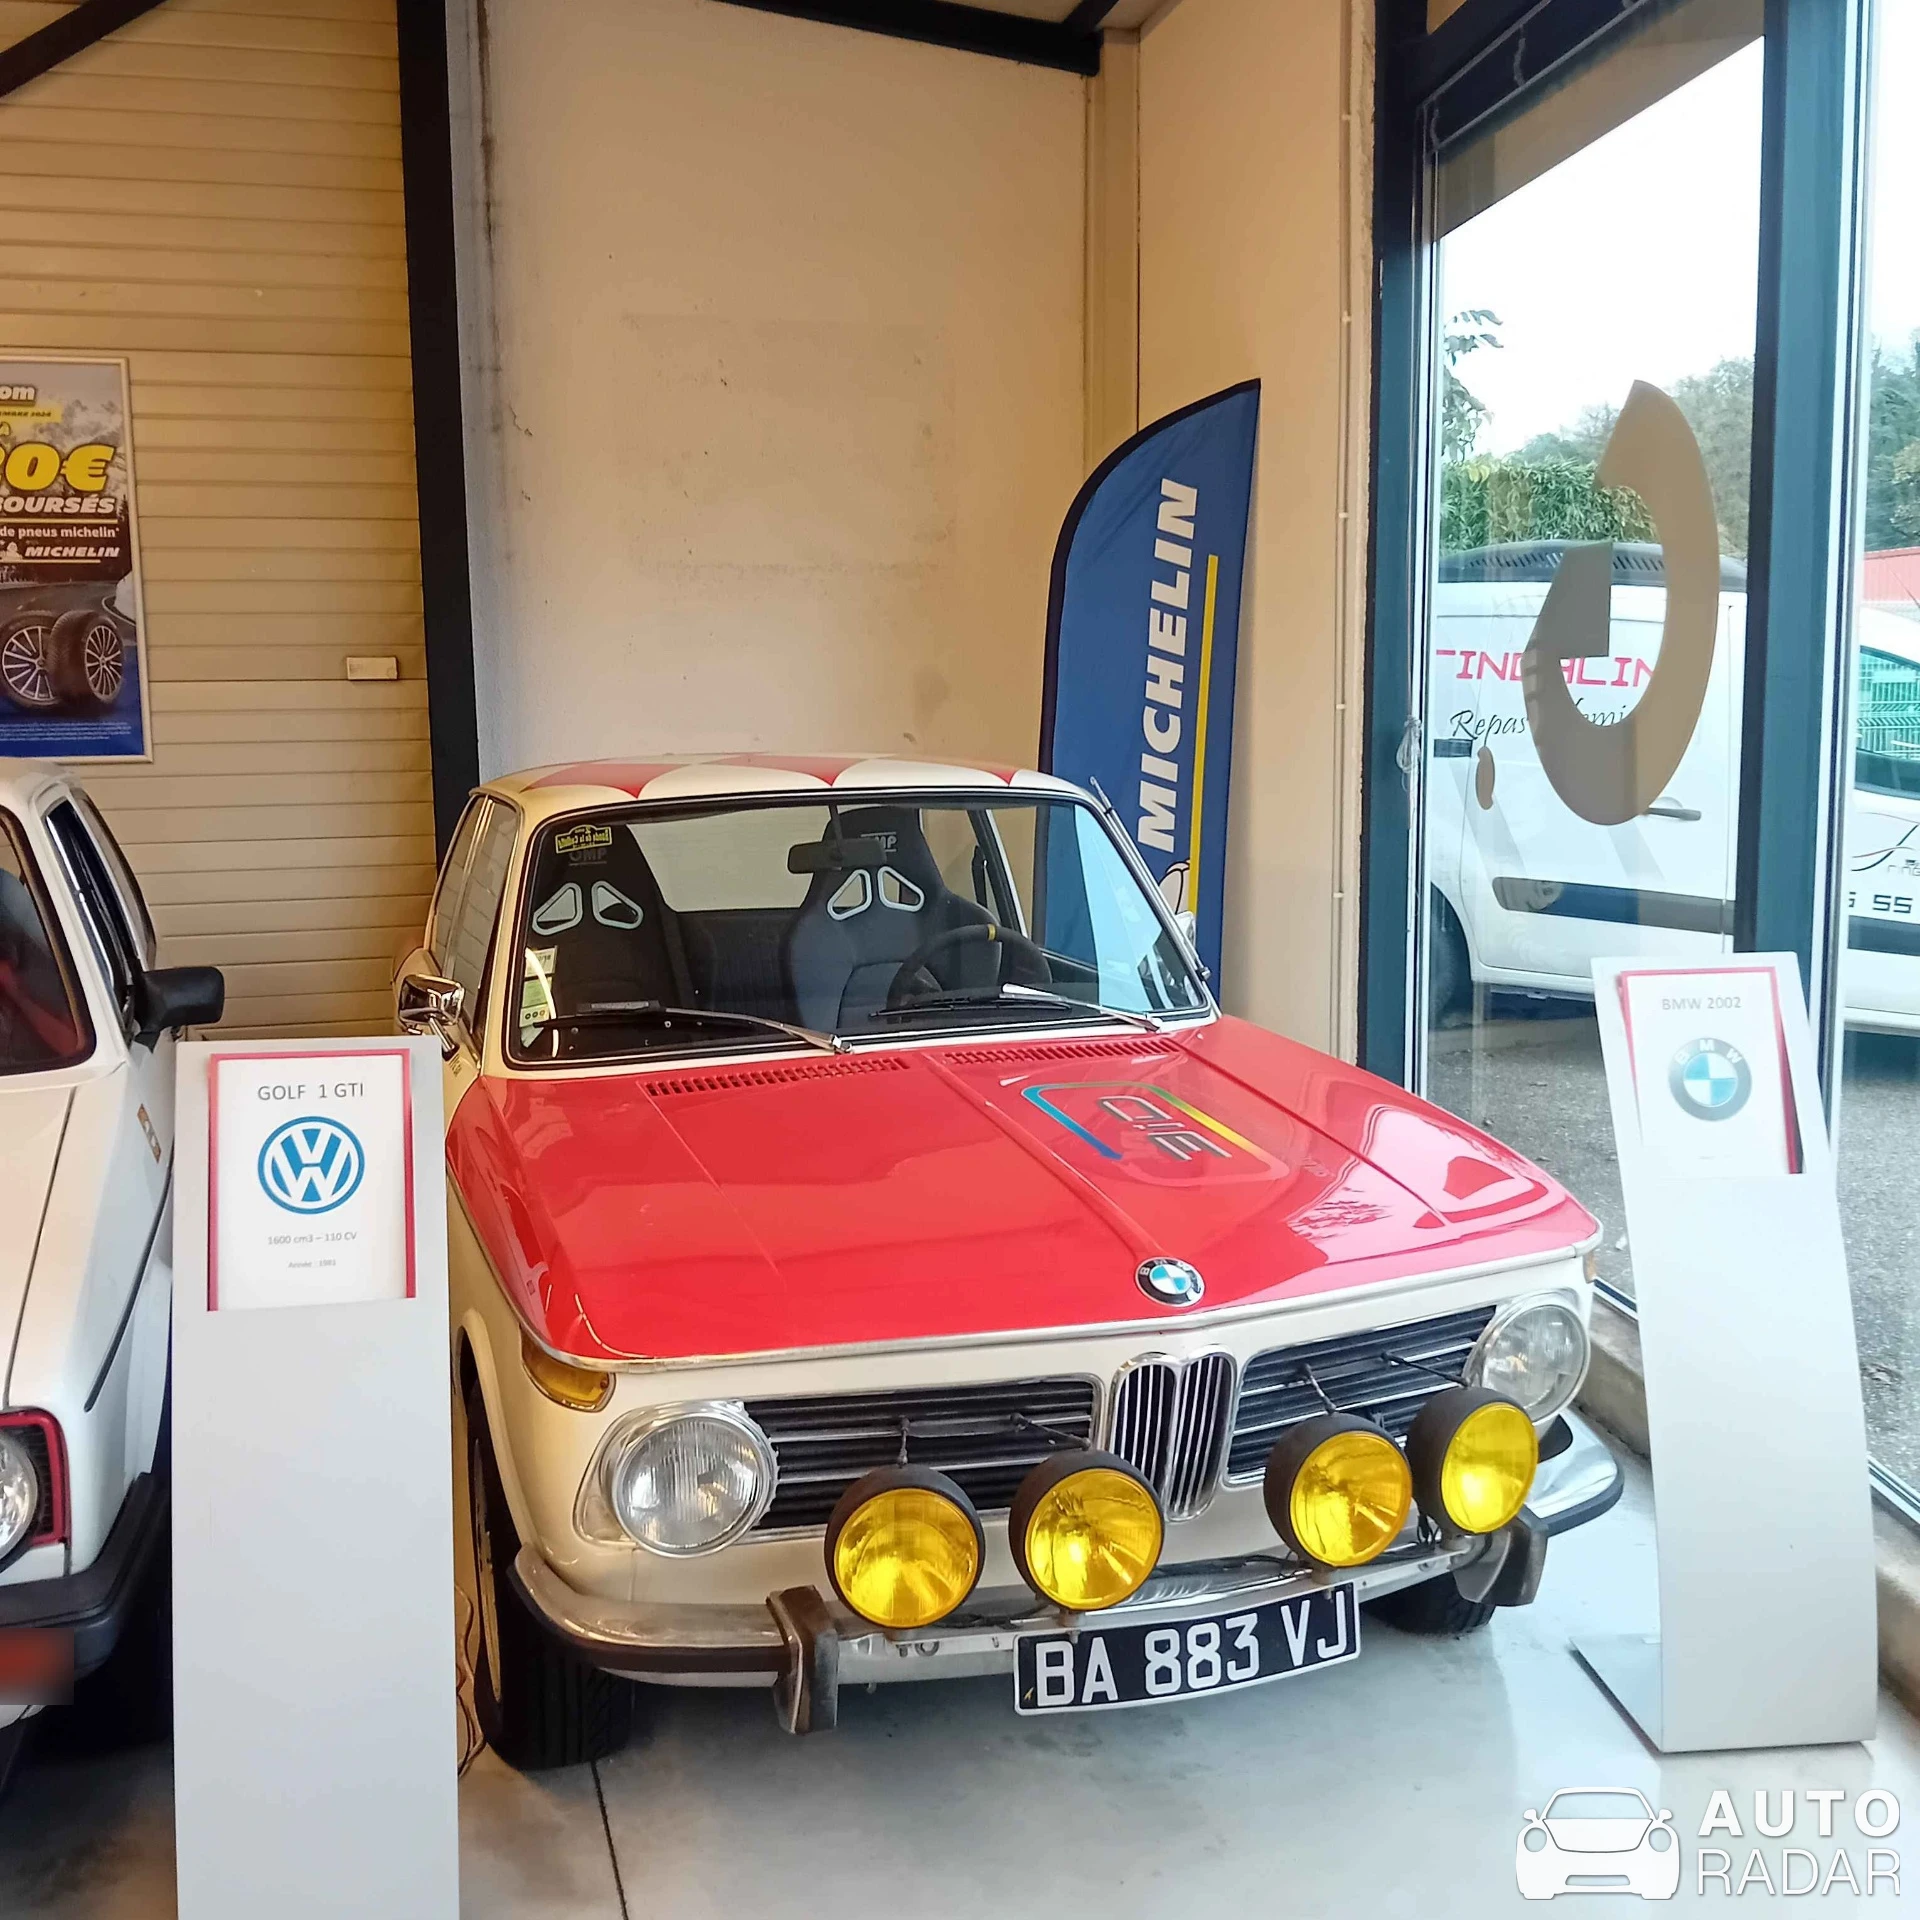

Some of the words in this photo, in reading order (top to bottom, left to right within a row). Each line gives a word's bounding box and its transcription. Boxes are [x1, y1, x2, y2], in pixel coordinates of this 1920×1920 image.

[0, 441, 116, 492] 0€
[0, 493, 116, 515] OURSÉS
[18, 527, 58, 540] pneus
[25, 546, 120, 558] MICHELIN
[1138, 478, 1198, 853] MICHELIN
[1662, 998, 1702, 1010] BMW
[1707, 996, 1741, 1009] 2002
[257, 1084, 306, 1101] GOLF
[318, 1084, 328, 1099] 1
[334, 1082, 364, 1098] GTI
[325, 1232, 342, 1242] 110
[1036, 1637, 1119, 1707] BA
[1144, 1613, 1260, 1696] 883
[1280, 1590, 1347, 1667] VJ
